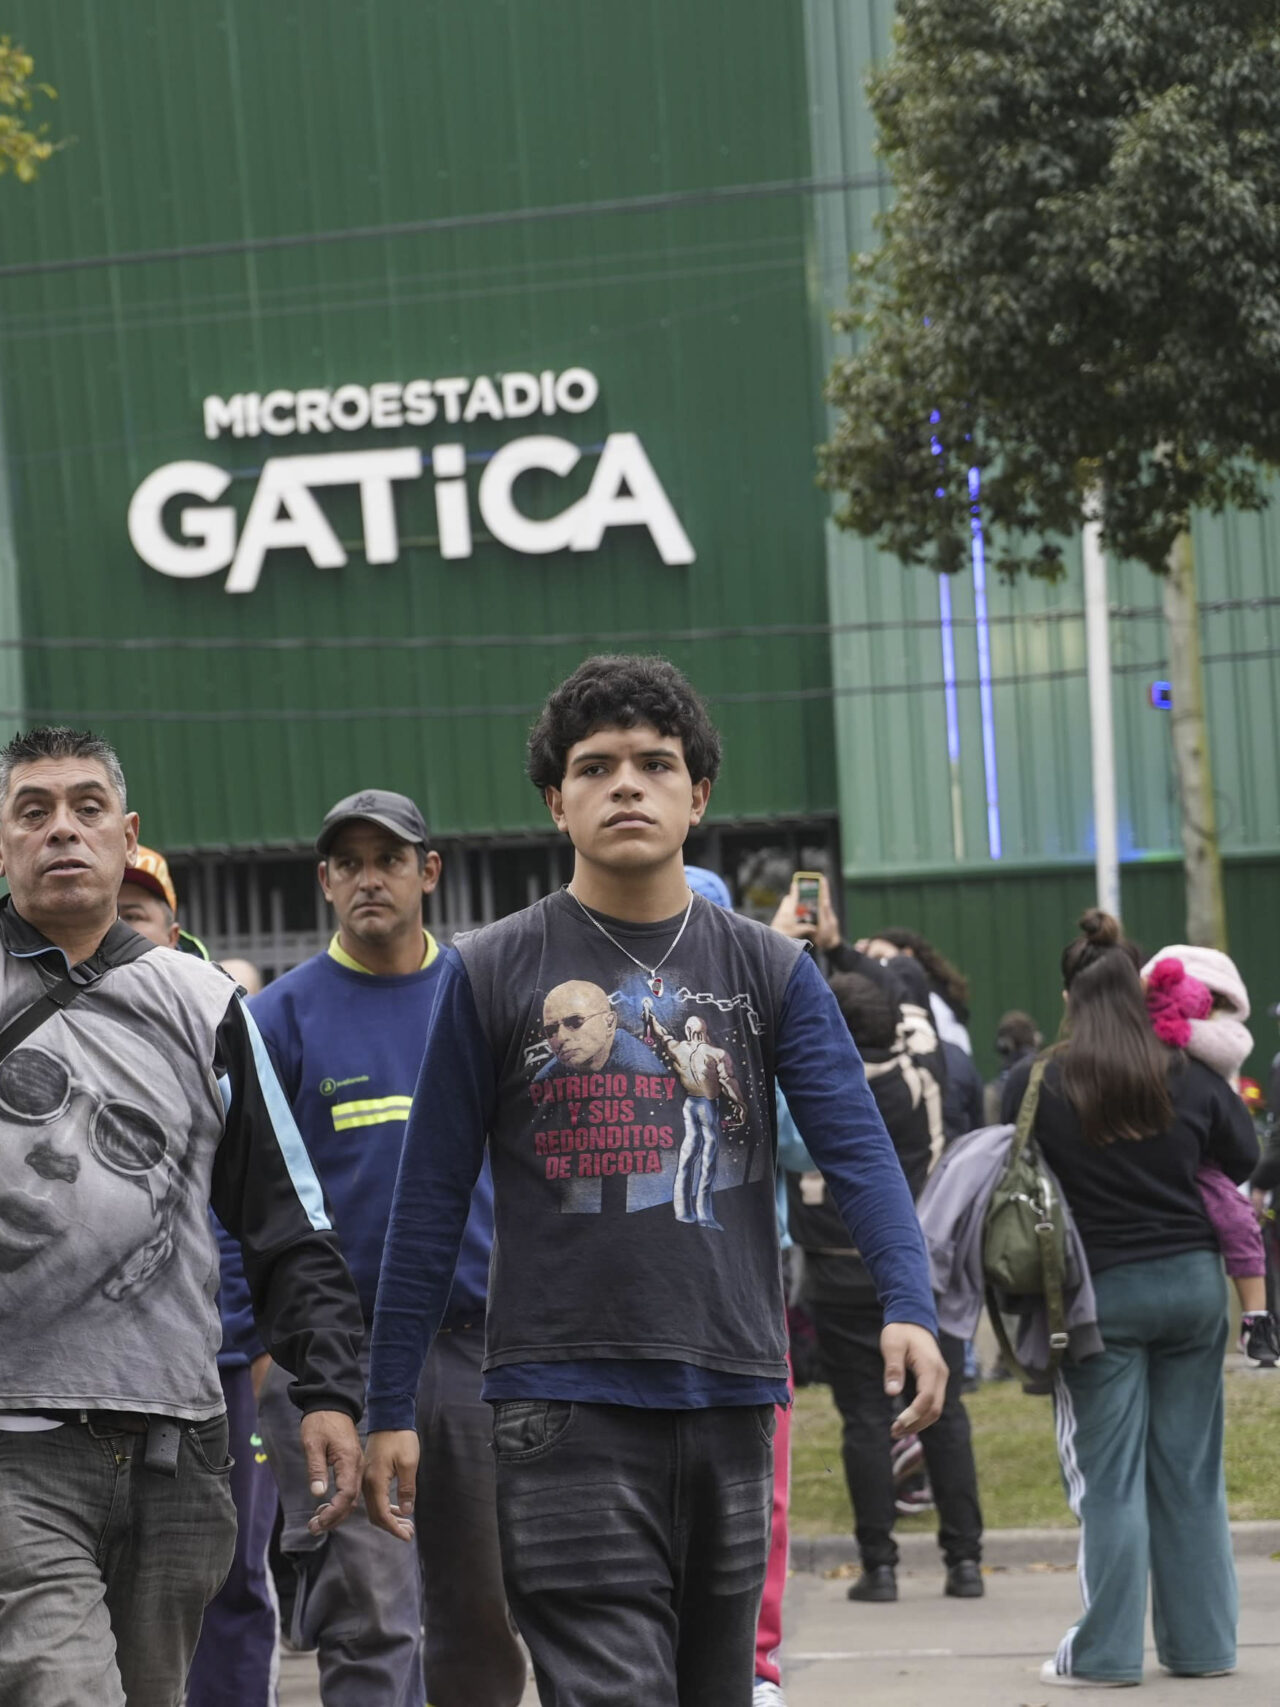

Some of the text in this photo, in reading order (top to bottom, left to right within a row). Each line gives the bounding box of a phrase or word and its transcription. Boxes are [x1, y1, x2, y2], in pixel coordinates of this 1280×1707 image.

[204, 367, 599, 440] MICROESTADIO
[530, 1074, 677, 1104] PATRICIO REY
[568, 1100, 635, 1126] Y SUS
[534, 1125, 674, 1156] REDONDITOS
[545, 1151, 663, 1180] DE RICOTA
